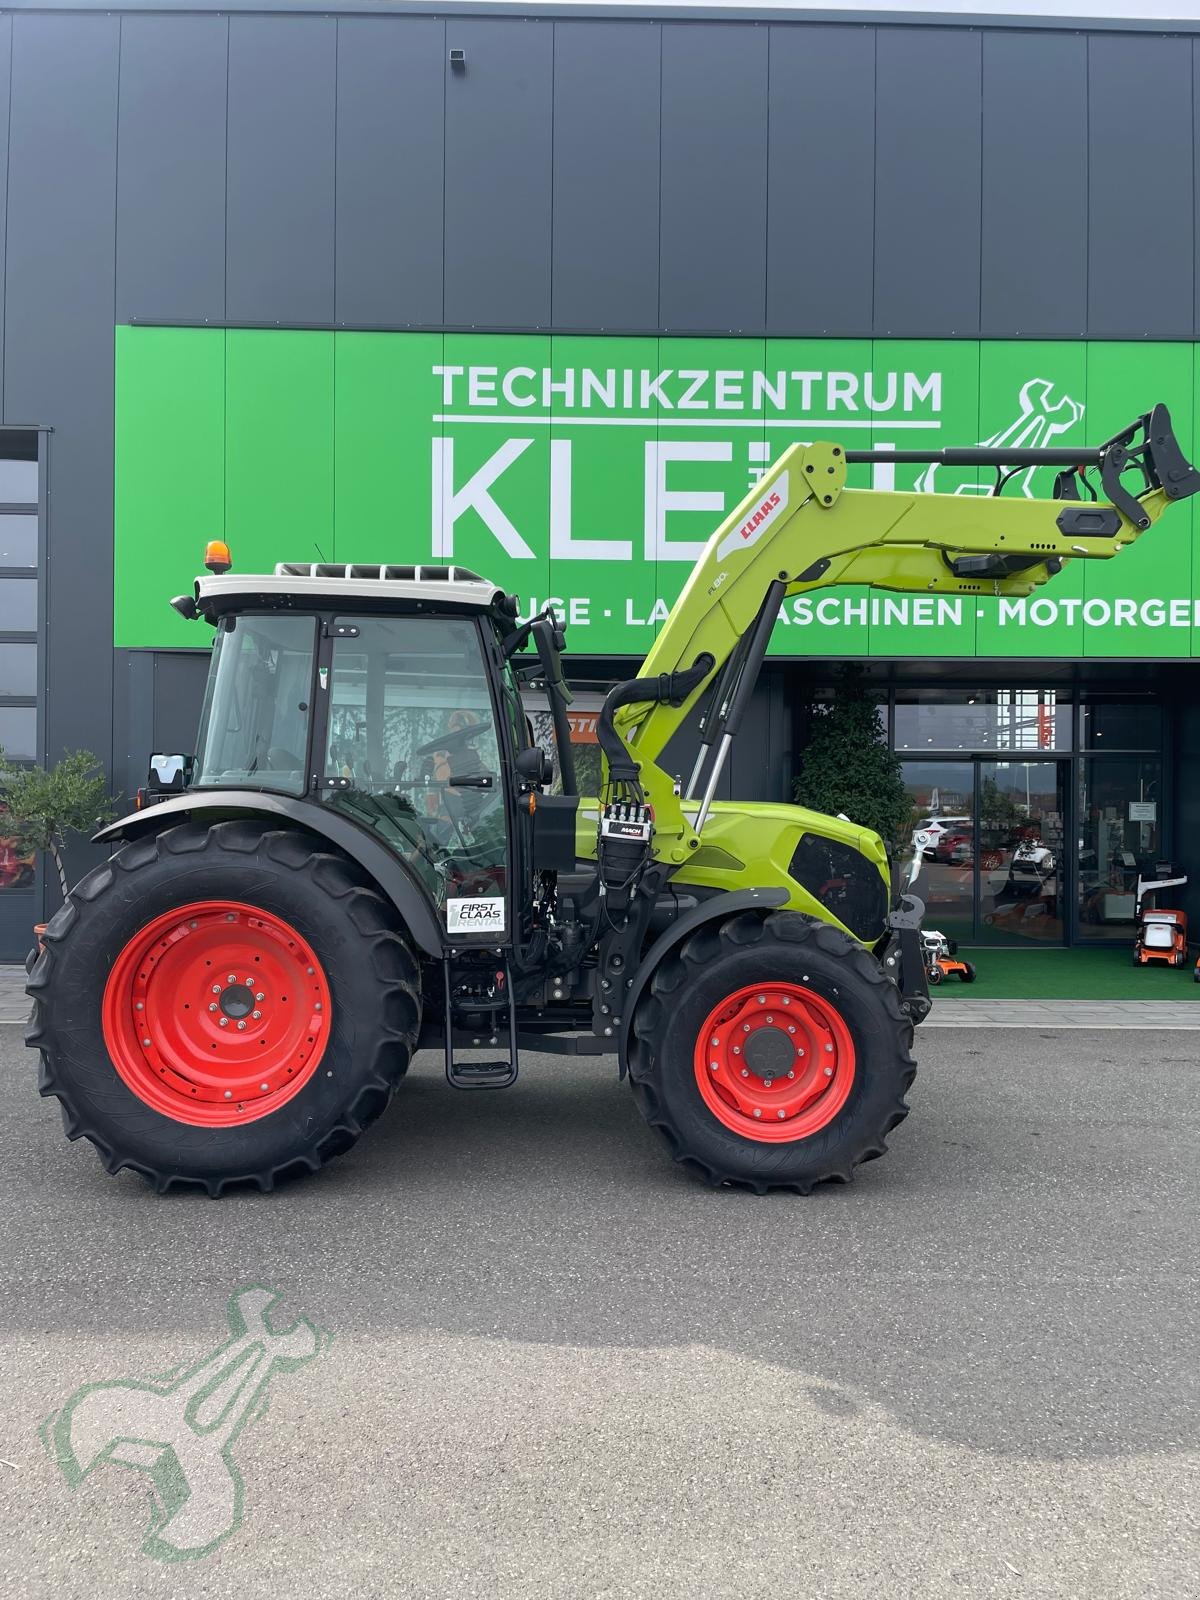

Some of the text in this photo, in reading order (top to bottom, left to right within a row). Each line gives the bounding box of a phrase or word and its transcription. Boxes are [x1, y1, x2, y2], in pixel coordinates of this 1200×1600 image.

[432, 365, 942, 411] TECHNIKZENTRUM
[740, 492, 781, 540] CLAAS
[999, 598, 1200, 627] MOTORGE
[567, 718, 597, 733] STI
[460, 911, 501, 919] CLAAS
[461, 903, 496, 912] FIRST
[458, 918, 503, 927] RENTAL
